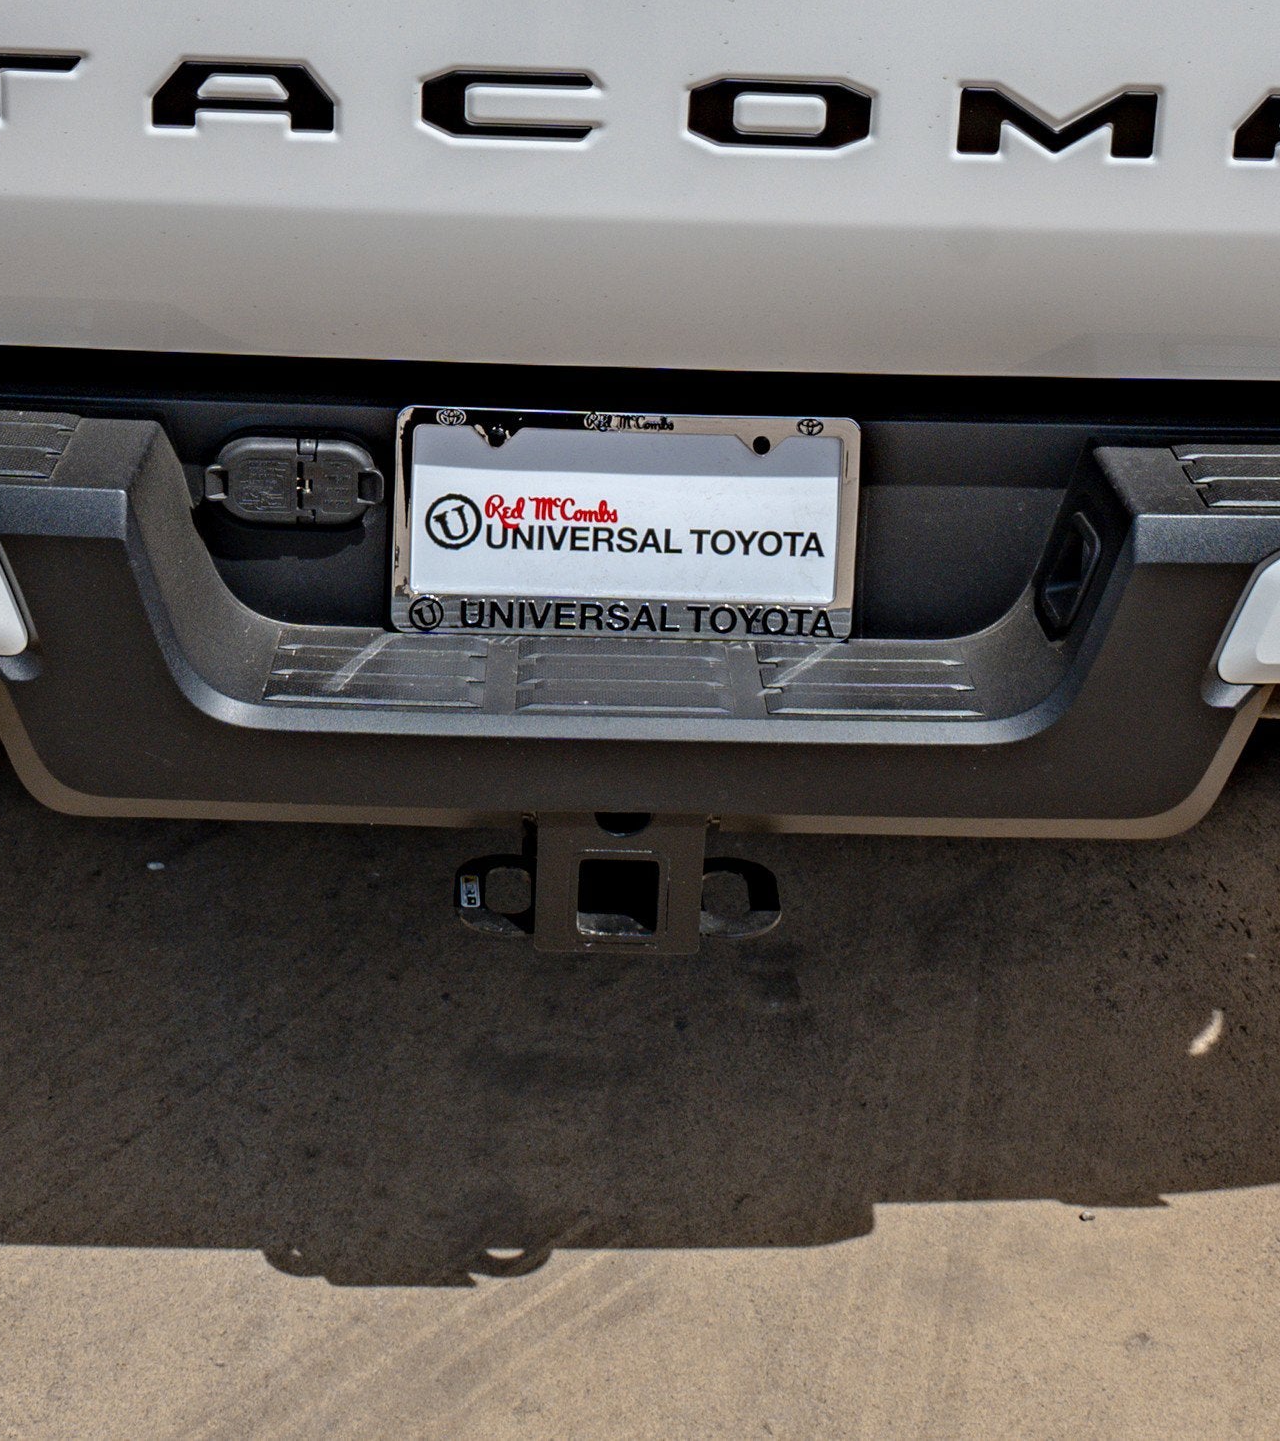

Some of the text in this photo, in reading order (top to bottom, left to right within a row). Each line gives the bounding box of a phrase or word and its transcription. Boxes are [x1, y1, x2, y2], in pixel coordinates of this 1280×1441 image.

[485, 494, 618, 529] Red McCombs
[485, 523, 683, 555] UNIVERSAL
[689, 528, 826, 558] TOYOTA
[459, 598, 680, 633] UNIVERSAL
[686, 604, 835, 639] TOYOTA
